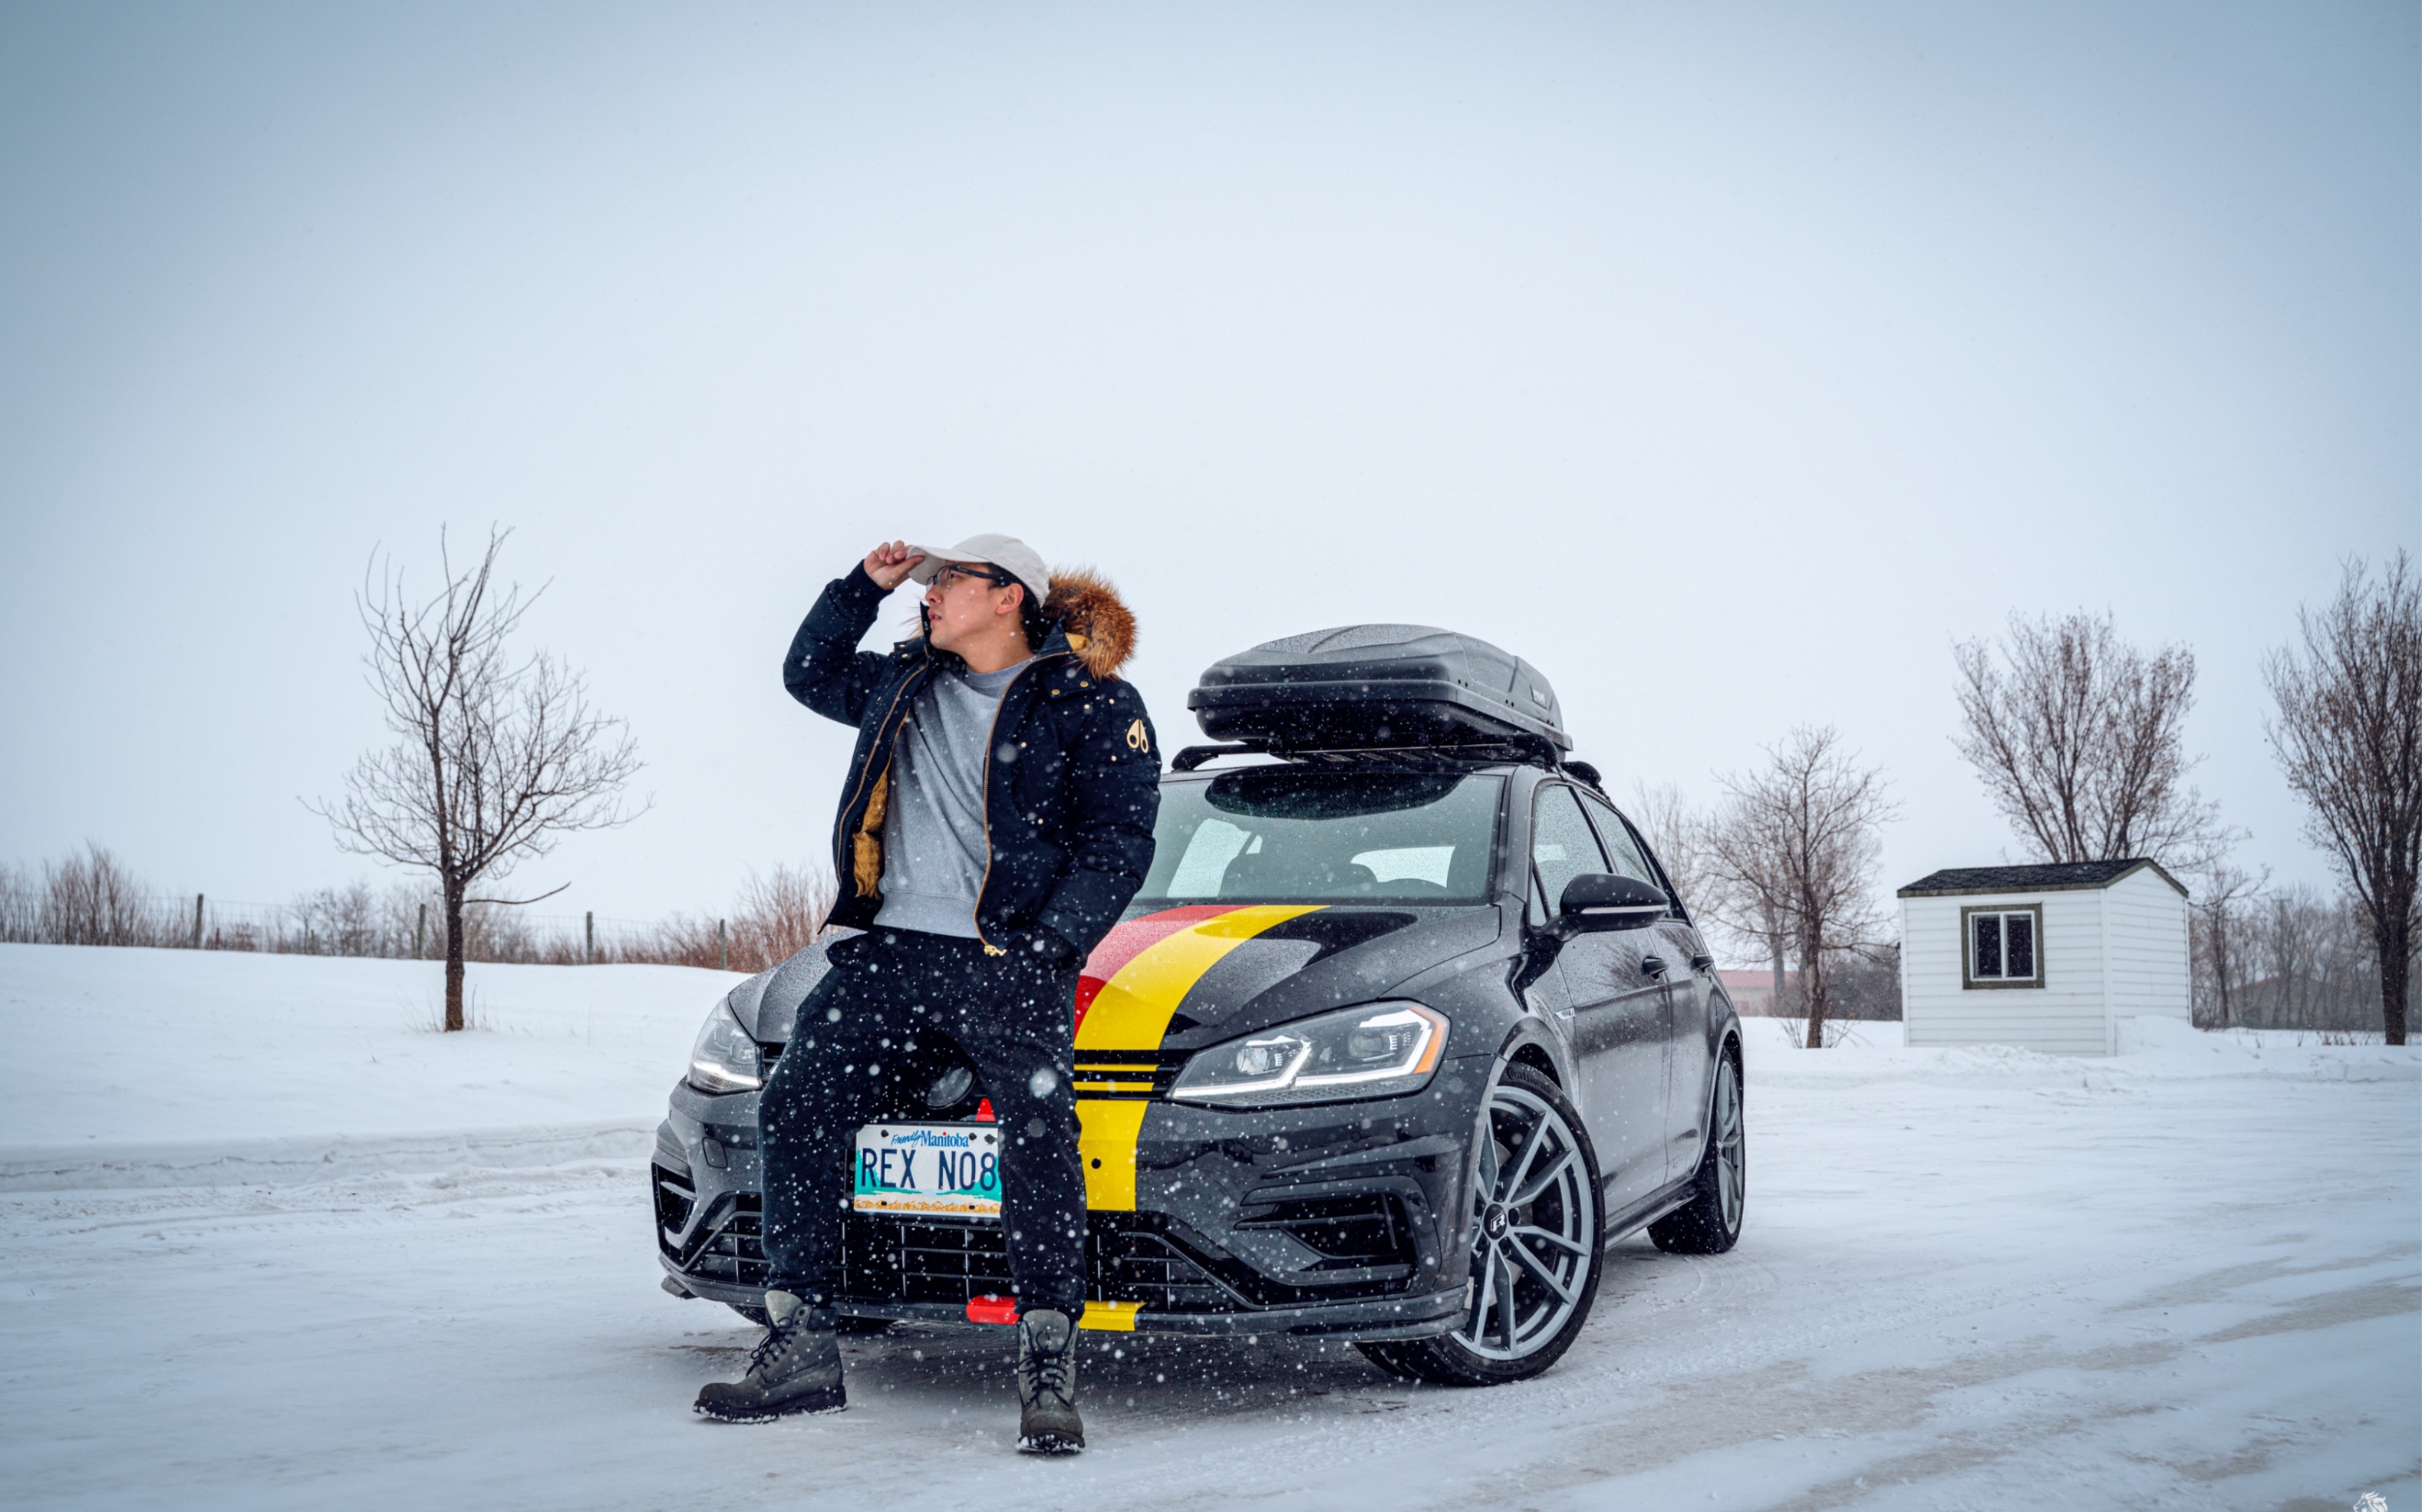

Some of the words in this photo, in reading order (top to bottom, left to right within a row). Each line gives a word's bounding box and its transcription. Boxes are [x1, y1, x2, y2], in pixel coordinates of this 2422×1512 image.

[891, 1130, 921, 1148] Friendly
[921, 1130, 969, 1148] Manitoba
[861, 1148, 916, 1188] REX
